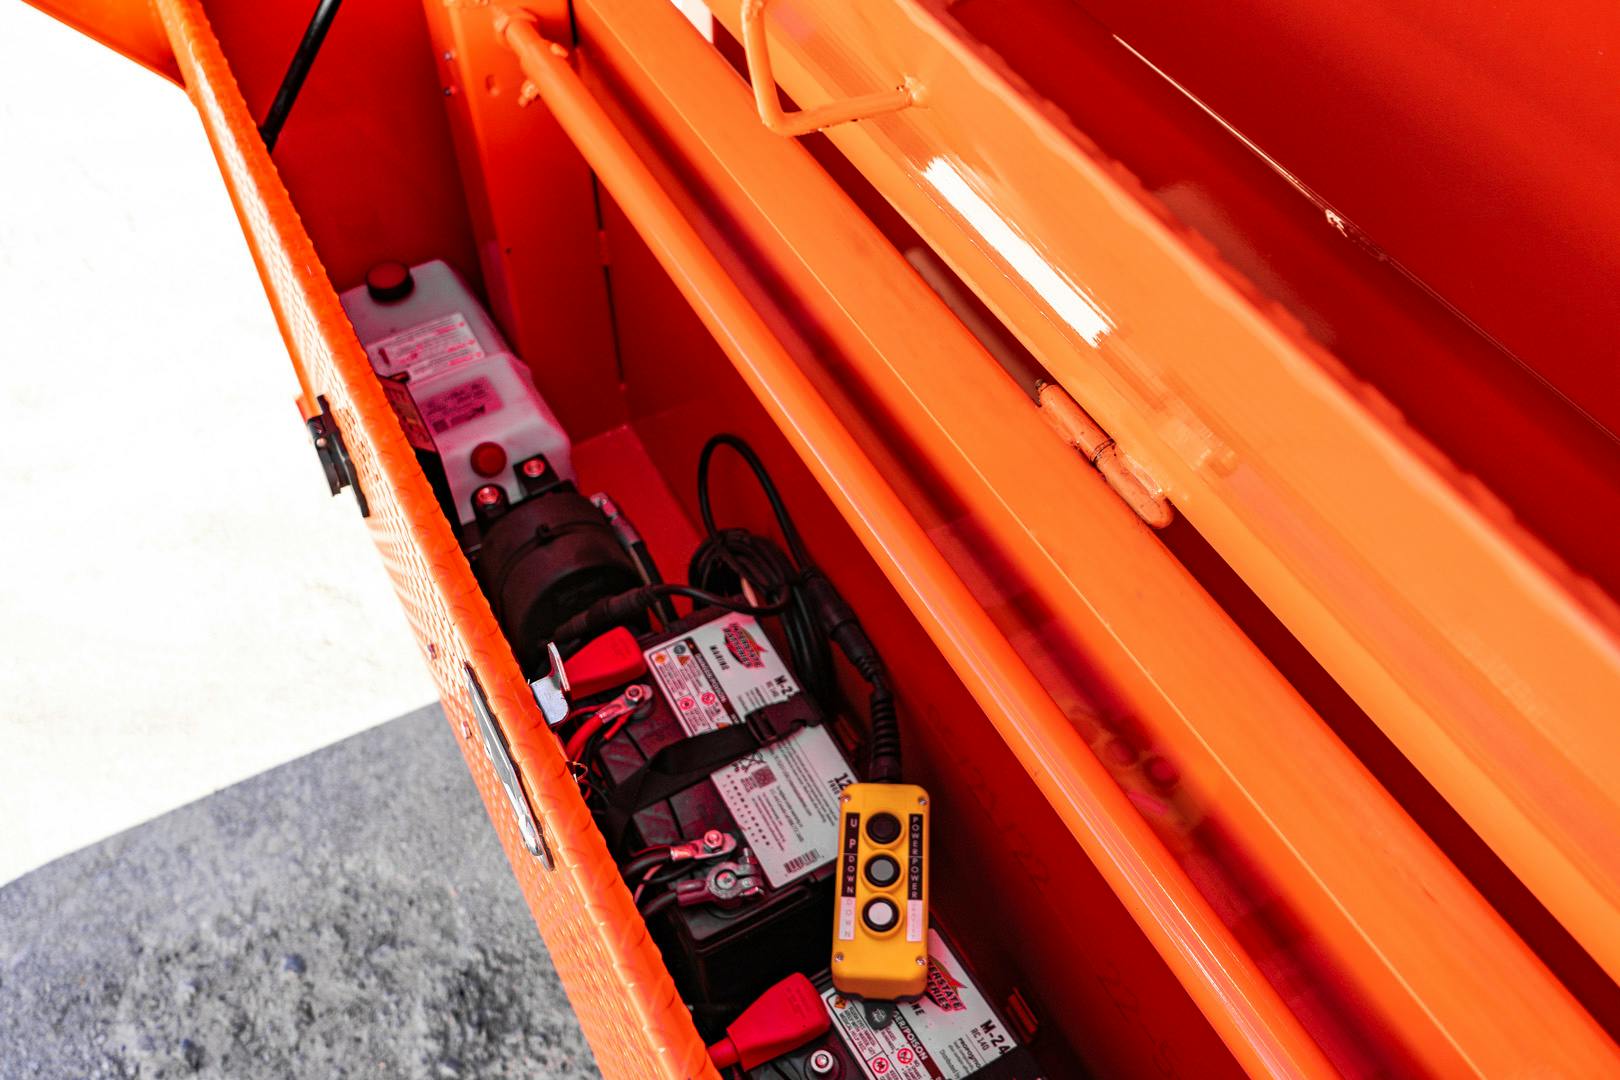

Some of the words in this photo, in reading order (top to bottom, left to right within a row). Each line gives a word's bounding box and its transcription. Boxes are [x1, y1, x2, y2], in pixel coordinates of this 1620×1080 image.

[911, 817, 920, 856] POWER
[847, 856, 855, 893] DOWN
[911, 857, 919, 898] POWER
[957, 1036, 981, 1070] PROPOSITIO
[976, 1036, 989, 1051] 140
